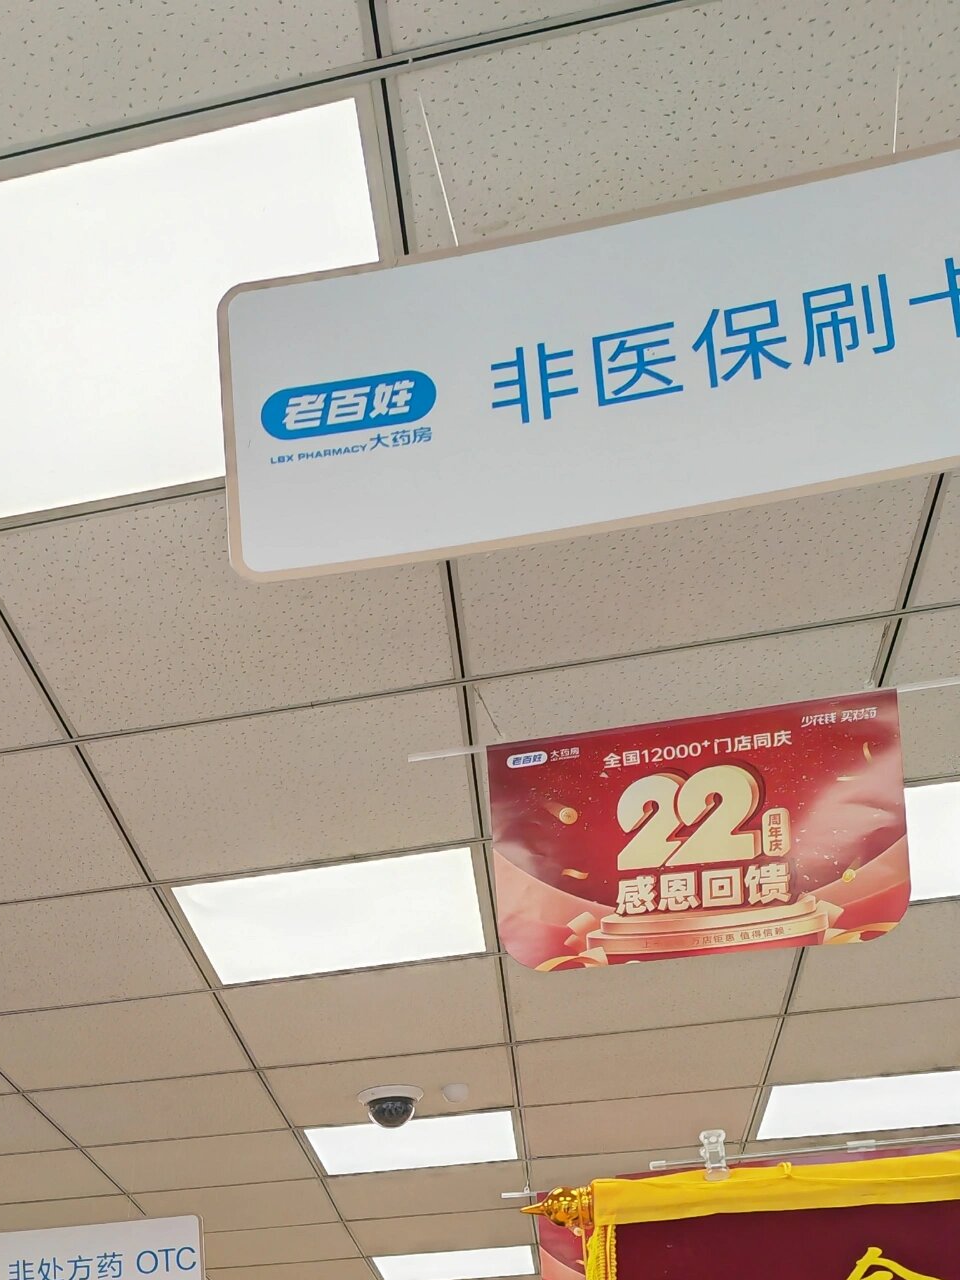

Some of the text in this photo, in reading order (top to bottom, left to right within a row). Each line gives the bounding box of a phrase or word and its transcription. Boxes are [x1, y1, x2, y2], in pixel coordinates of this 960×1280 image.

[281, 377, 416, 432] 老百姓
[368, 426, 434, 450] 大药房
[269, 442, 369, 466] LBX PHARMACY
[800, 710, 837, 728] 少花钱
[511, 752, 544, 767] 老百姓
[616, 764, 762, 871] 22
[767, 812, 783, 854] 周年庆
[614, 863, 793, 916] 感恩回馈
[135, 1246, 198, 1275] OTC
